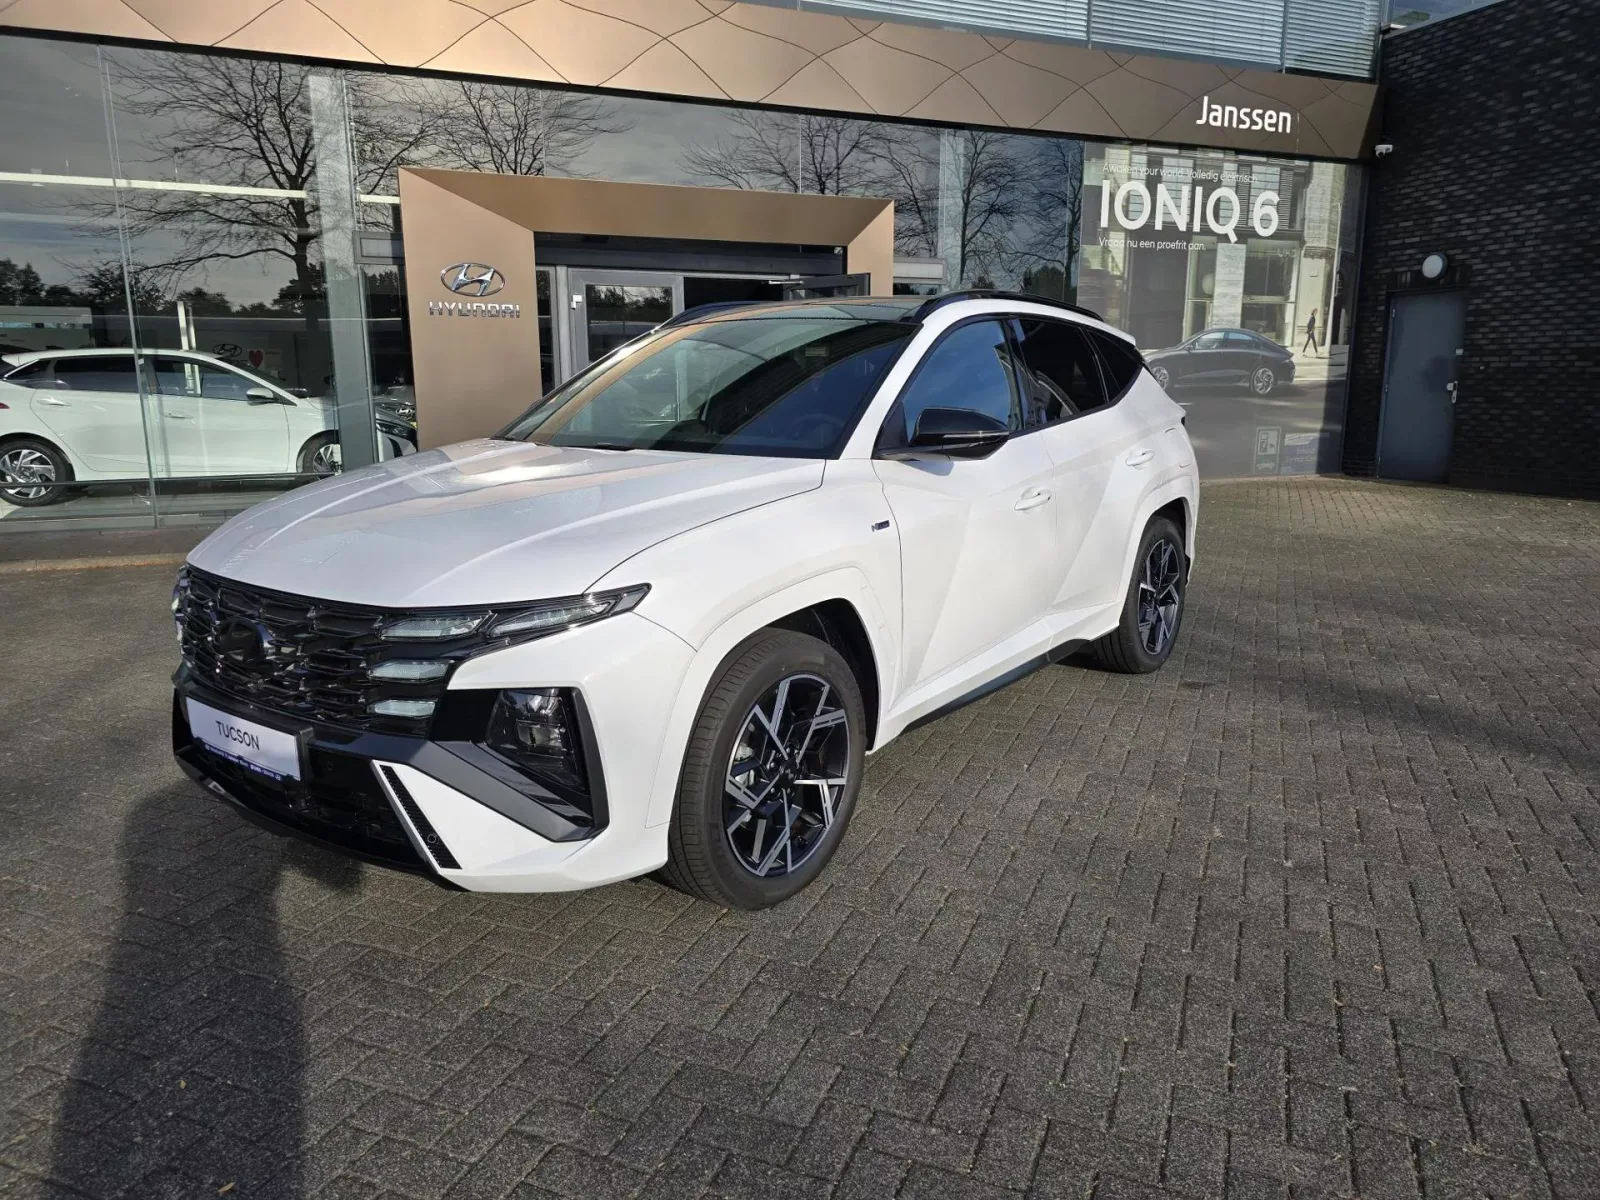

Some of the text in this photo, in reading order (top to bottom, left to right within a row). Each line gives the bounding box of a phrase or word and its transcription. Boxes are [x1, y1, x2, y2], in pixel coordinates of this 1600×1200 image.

[1196, 95, 1292, 134] Janssen
[1102, 162, 1138, 175] Awaken
[1139, 166, 1158, 178] your
[1187, 168, 1219, 182] Volledig
[1100, 179, 1281, 244] IONIQ 6
[1127, 239, 1138, 249] nu
[1139, 240, 1155, 250] een
[1157, 239, 1187, 251] proefrit
[429, 300, 521, 319] HYUNDAI
[215, 720, 260, 751] TUCSON
